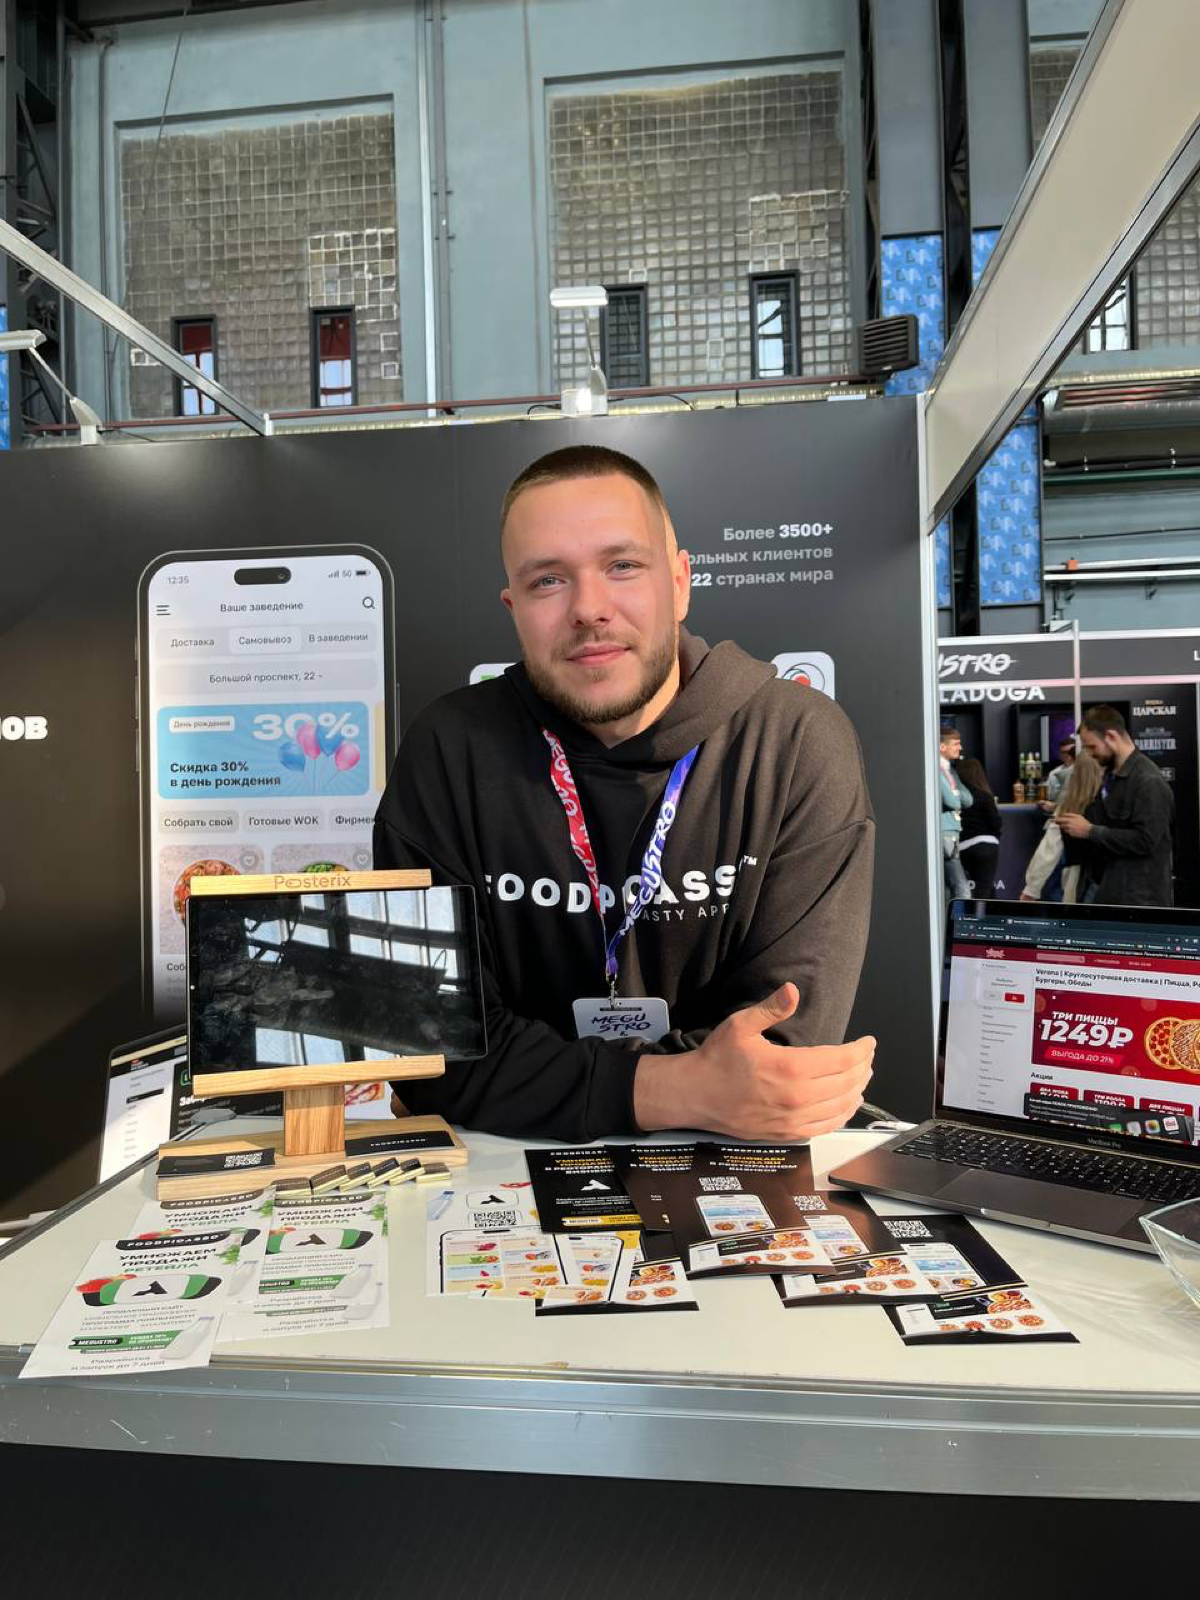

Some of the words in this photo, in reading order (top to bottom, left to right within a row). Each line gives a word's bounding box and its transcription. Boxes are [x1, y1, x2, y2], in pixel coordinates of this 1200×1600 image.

[723, 528, 775, 541] Более
[779, 523, 833, 538] 3500+
[689, 550, 748, 565] ольных
[752, 547, 833, 562] клиентов
[691, 573, 712, 586] 22
[716, 573, 785, 587] странах
[790, 569, 834, 584] мира
[220, 603, 247, 612] Ваше
[249, 602, 304, 612] заведение
[171, 638, 215, 647] Доставка
[238, 636, 292, 645] Самовывоз
[309, 634, 315, 642] В
[317, 633, 368, 642] заведении
[209, 673, 251, 683] Большой
[254, 673, 301, 684] проспект,
[303, 672, 315, 681] 22
[939, 686, 1045, 702] LADOGA
[0, 716, 48, 740] ОВ
[253, 712, 360, 740] 30%
[170, 762, 218, 774] Скидка
[221, 761, 249, 772] 30%
[170, 779, 177, 787] в
[181, 777, 211, 788] день
[215, 776, 281, 789] рождения
[164, 818, 206, 829] Собрать
[208, 817, 233, 827] свой
[249, 817, 291, 826] Готовые
[294, 815, 319, 825] WOK
[274, 875, 351, 890] Posterix
[166, 963, 186, 971] Соб
[1123, 975, 1158, 985] доставка
[591, 1013, 646, 1024] MEGU
[1052, 1011, 1073, 1021] ТРИ
[1075, 1014, 1119, 1026] ПИЦЦЫ
[599, 1022, 651, 1033] STRO
[1051, 1050, 1085, 1061] ВЫГОДА
[1085, 1054, 1099, 1063] ДО
[1031, 1072, 1053, 1080] Акции
[119, 1248, 217, 1261] УМНОЖАЕМ
[121, 1255, 208, 1267] ПРОДАЖИ
